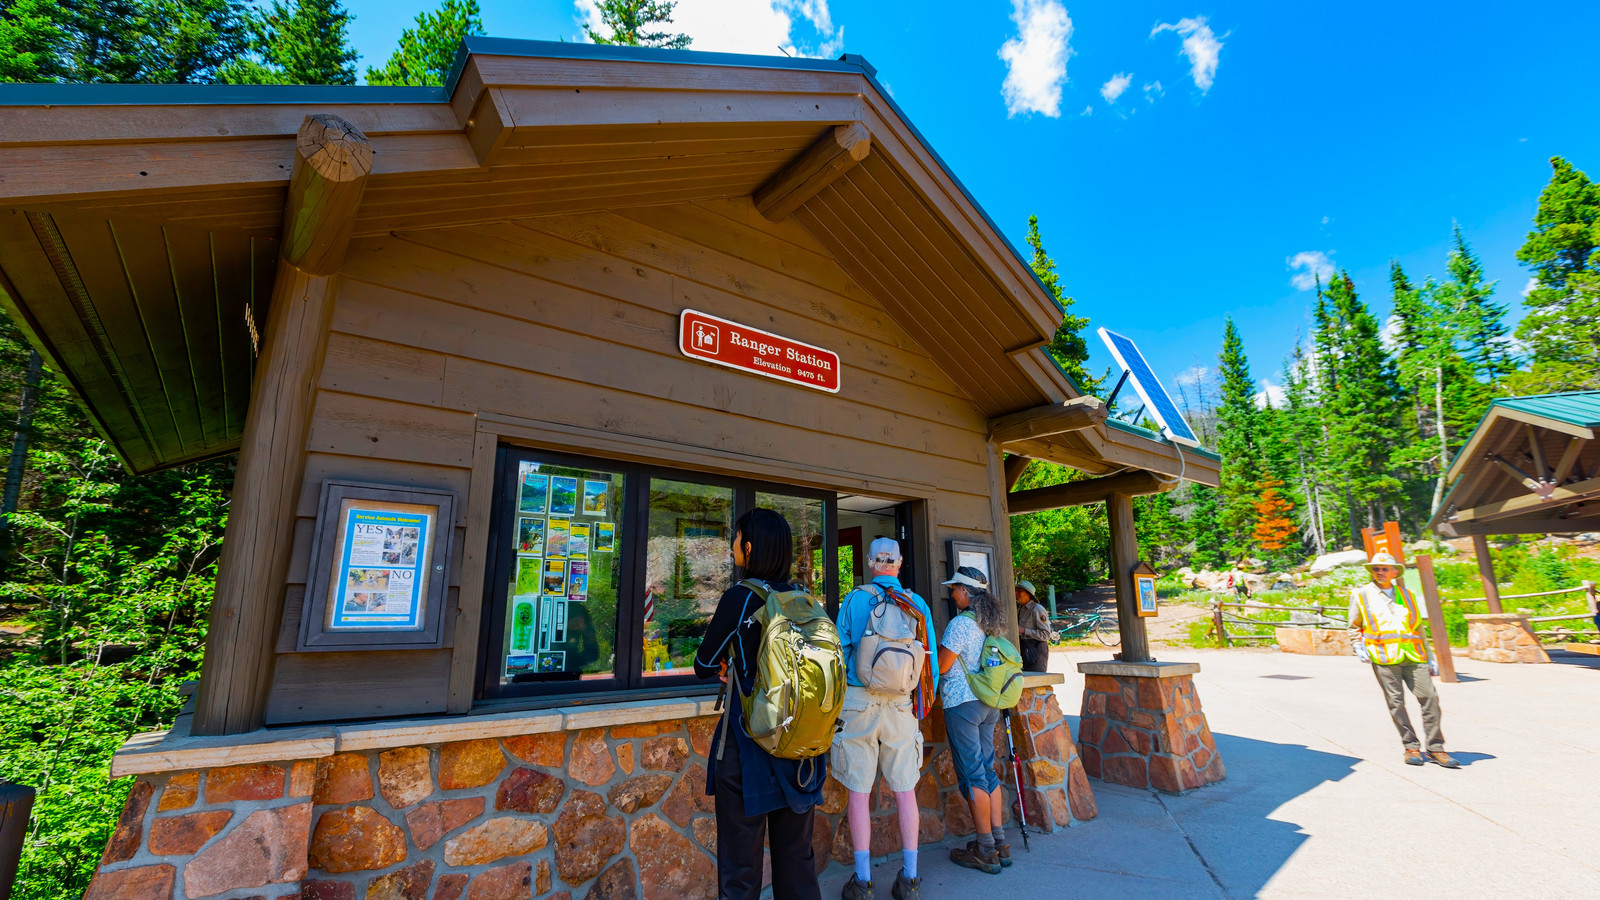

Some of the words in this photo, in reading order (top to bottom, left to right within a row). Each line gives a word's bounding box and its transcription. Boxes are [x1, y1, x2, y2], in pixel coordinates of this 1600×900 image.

[730, 331, 782, 356] Ranger
[786, 347, 832, 370] Station
[753, 356, 792, 373] Elevation
[797, 369, 815, 380] 9475
[816, 373, 826, 382] ft.
[356, 524, 384, 535] YES
[391, 570, 413, 580] NO
